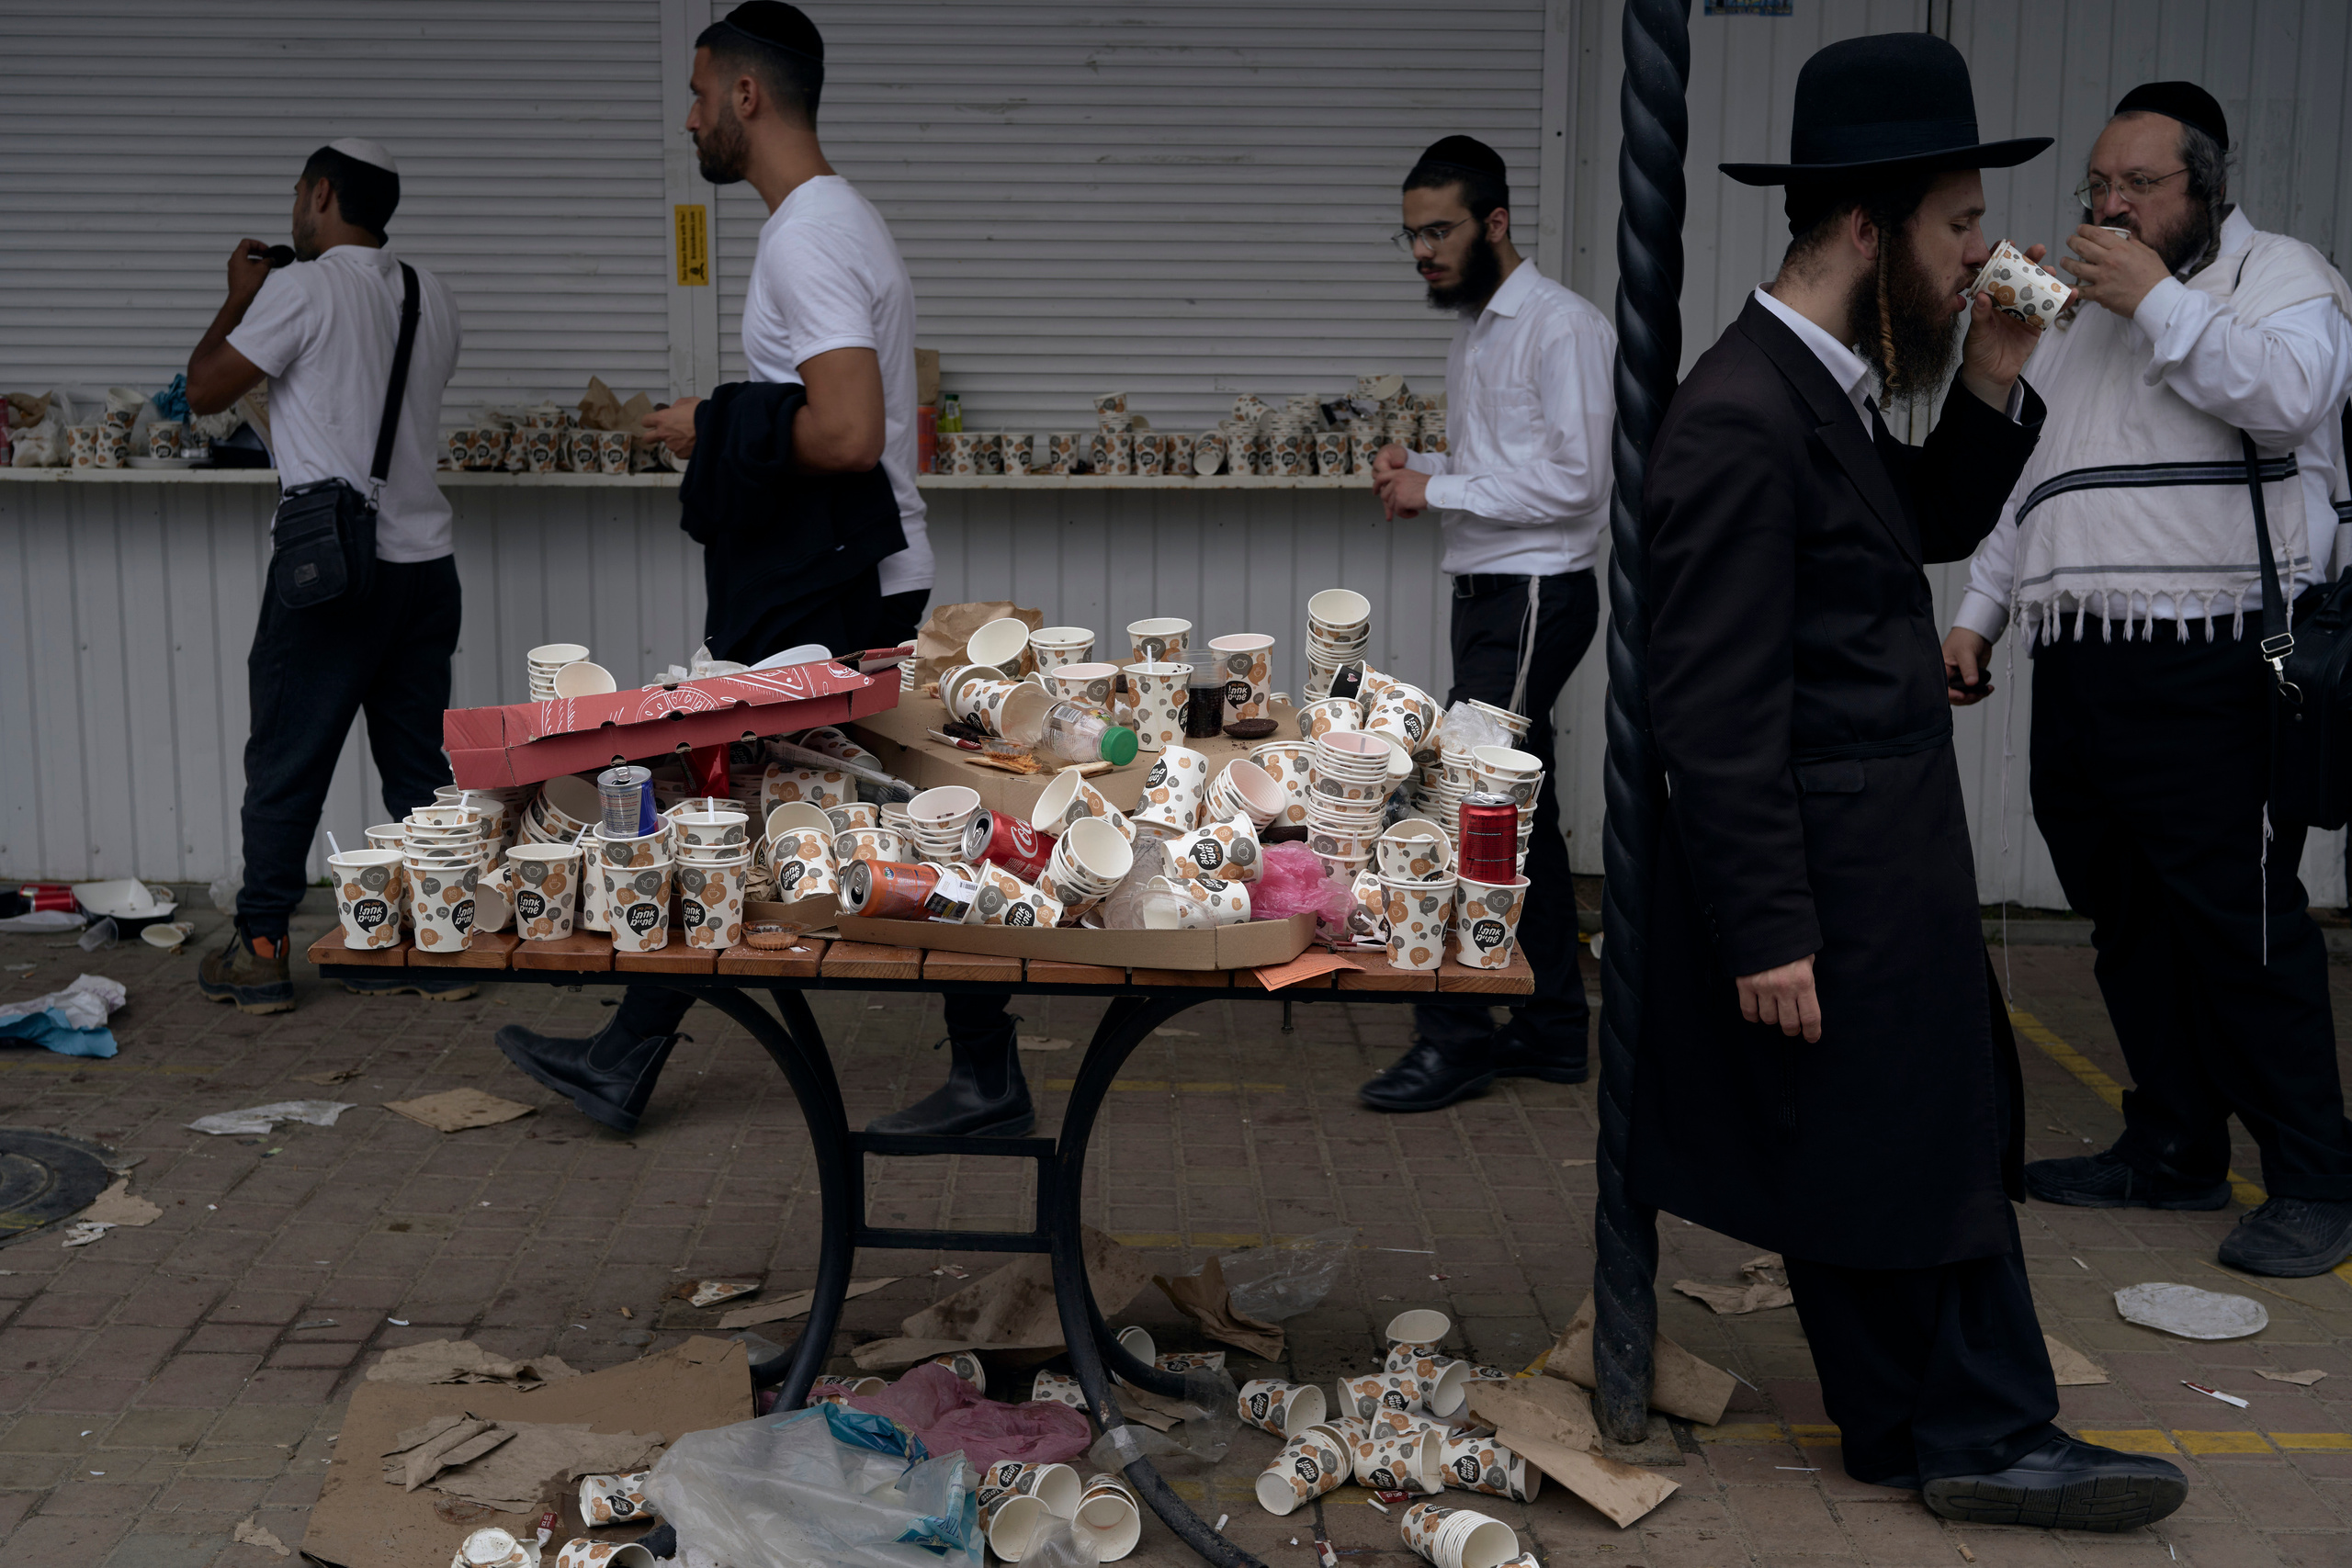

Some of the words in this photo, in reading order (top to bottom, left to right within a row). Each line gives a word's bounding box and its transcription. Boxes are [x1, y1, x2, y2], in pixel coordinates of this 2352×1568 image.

[359, 905, 383, 916] אחת!
[632, 909, 655, 919] אחת!
[1478, 924, 1502, 936] אחת!
